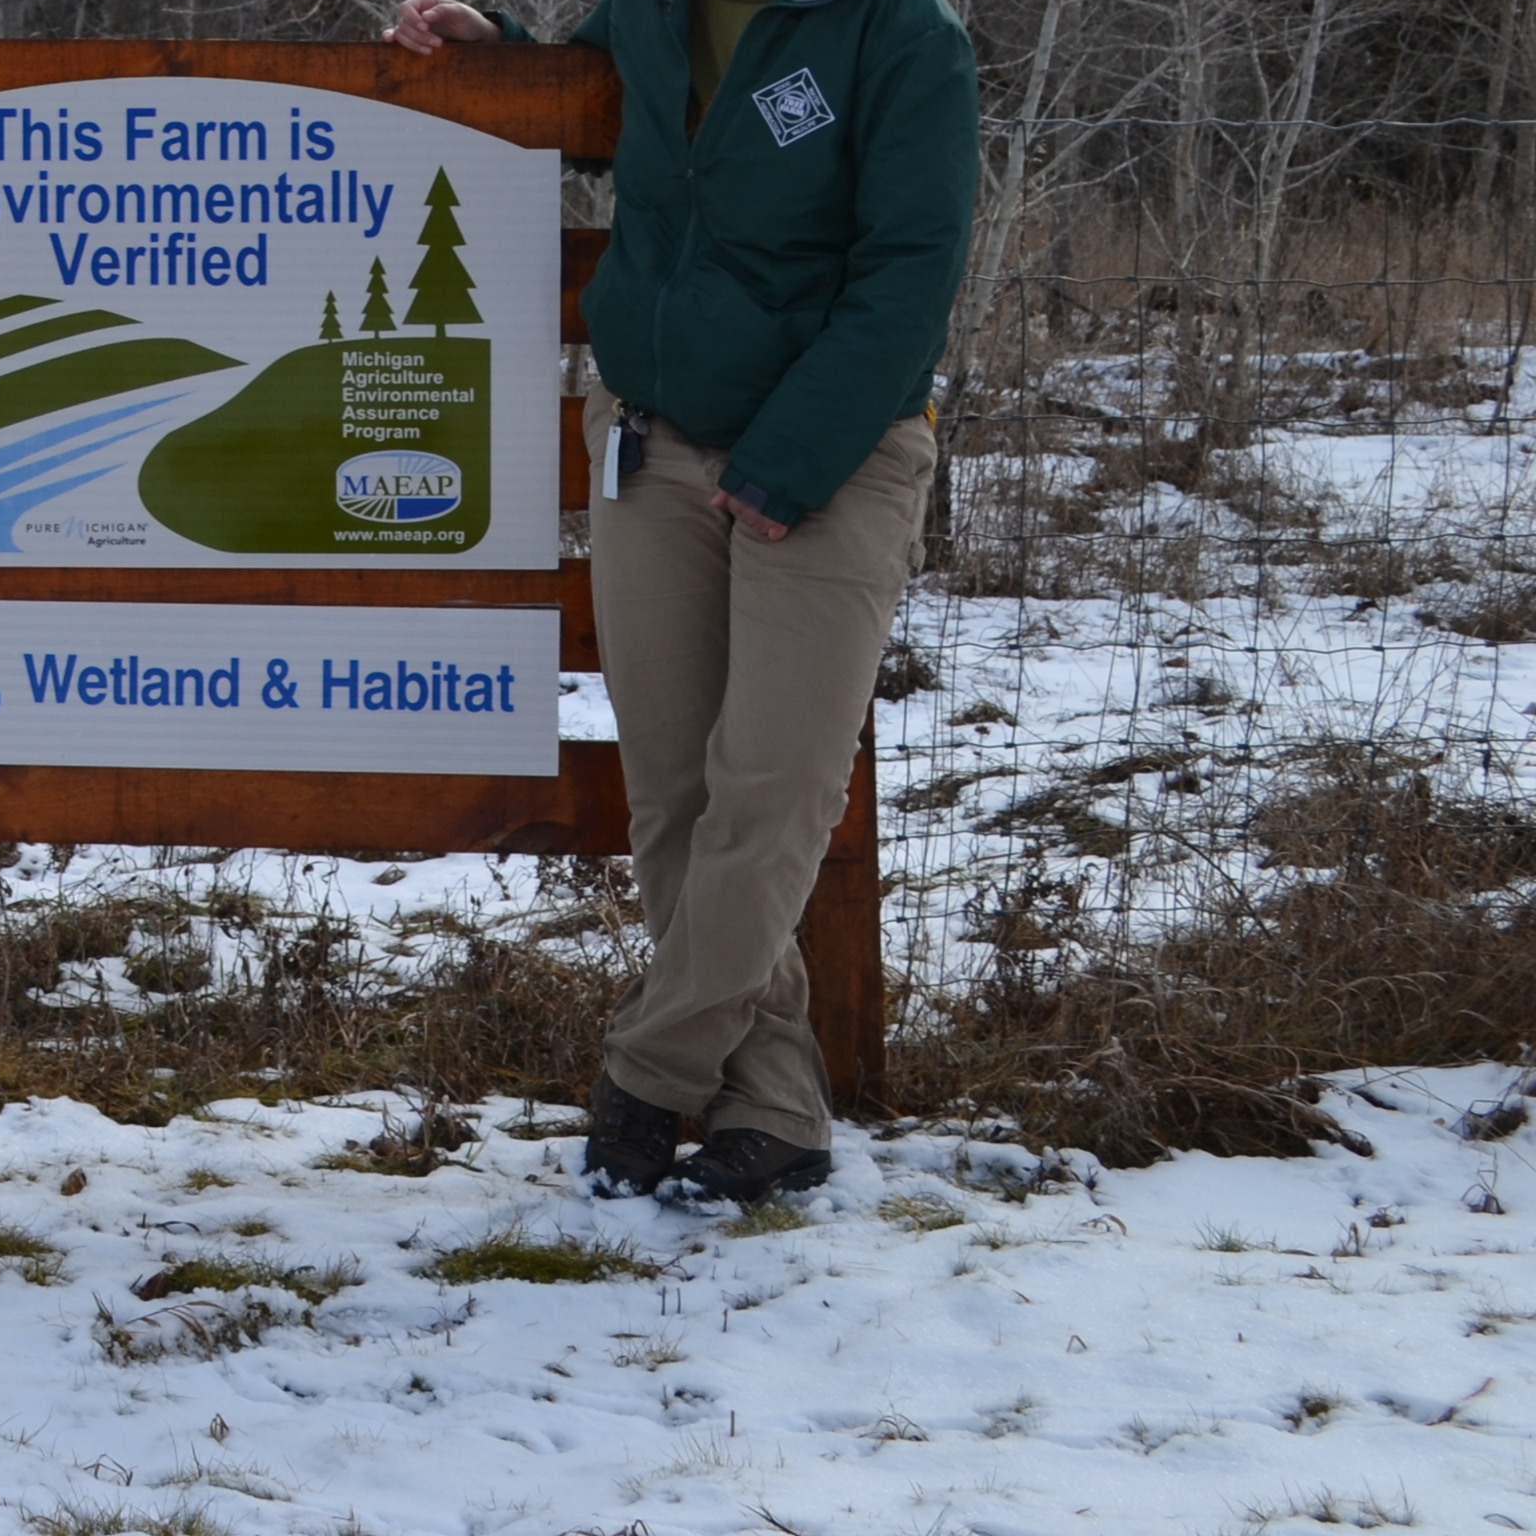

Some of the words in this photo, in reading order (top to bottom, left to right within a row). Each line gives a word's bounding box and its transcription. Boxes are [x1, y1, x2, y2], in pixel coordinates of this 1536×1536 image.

[126, 107, 267, 162] Farm
[290, 107, 335, 162] is
[49, 231, 267, 287] Verified
[342, 352, 425, 370] Michigan
[342, 370, 444, 387] Agriculture
[342, 388, 475, 403] Environmental
[342, 405, 440, 420] Assurance
[342, 424, 421, 442] Program
[342, 475, 453, 497] MAEAP
[26, 523, 61, 533] PURE
[87, 536, 146, 548] Agriculture
[333, 530, 466, 545] www.maeap.org
[24, 653, 240, 709] Wetland
[261, 658, 300, 710] &
[322, 658, 515, 713] Habitat
